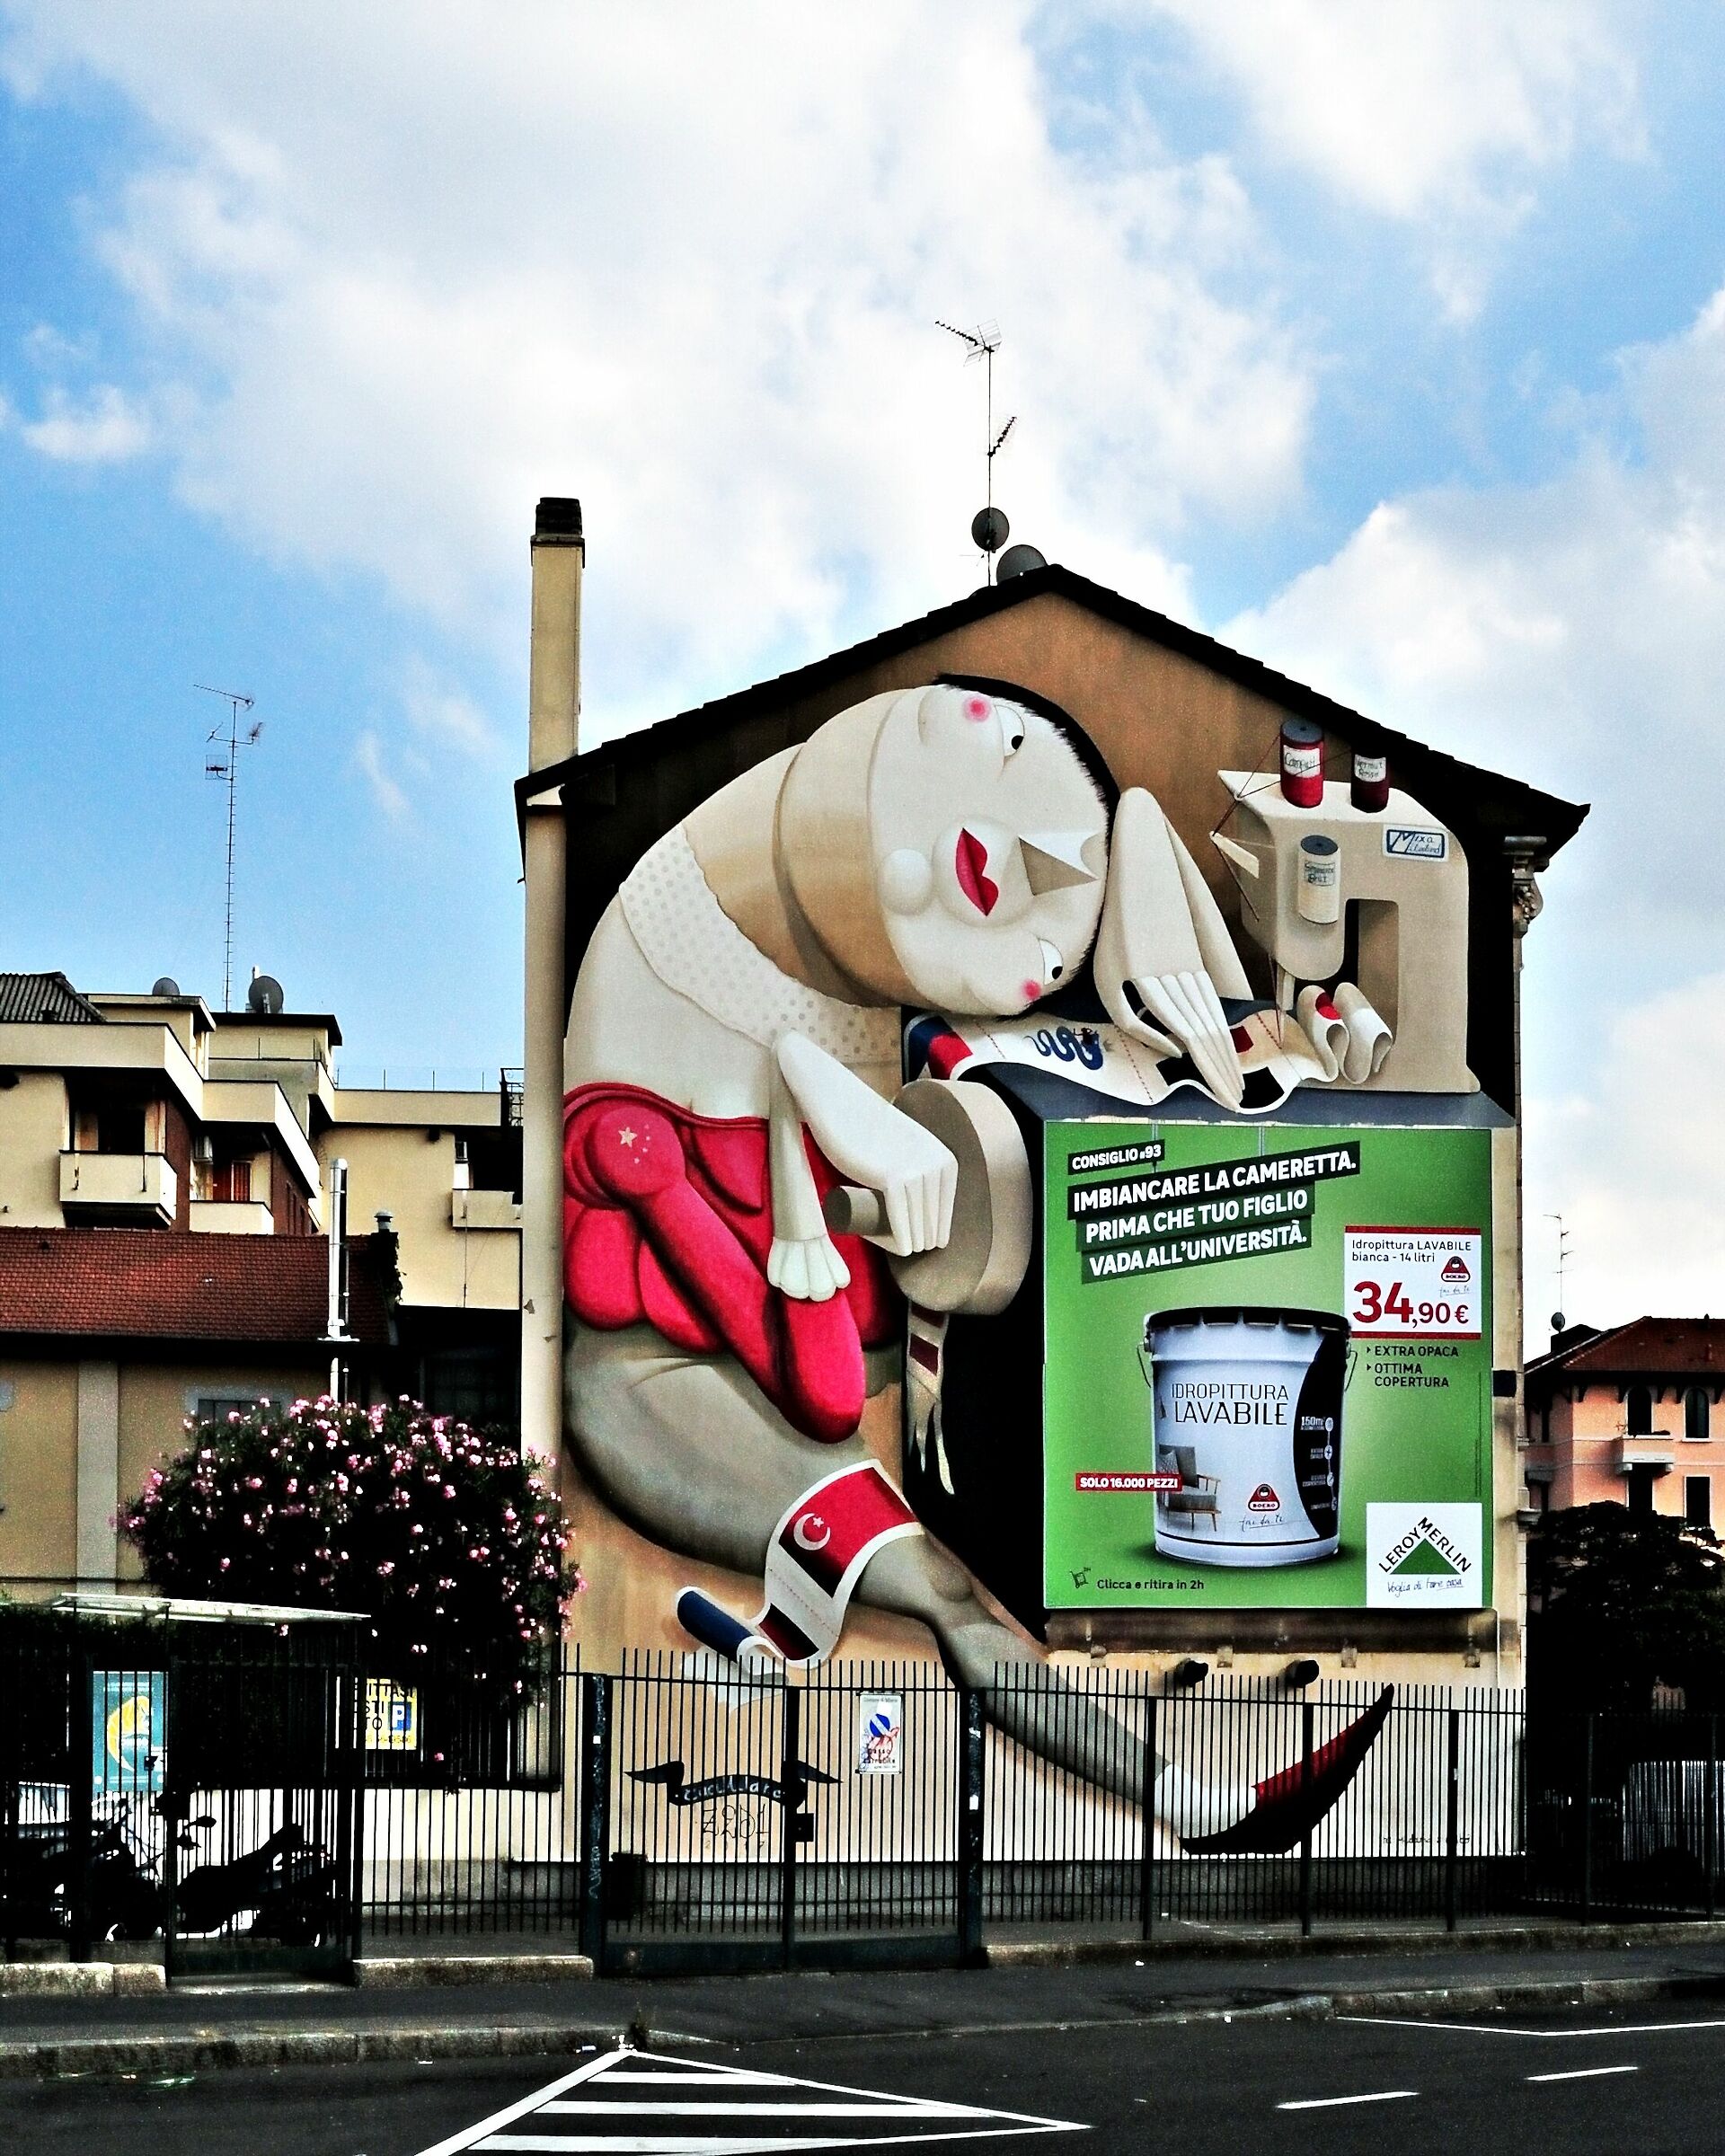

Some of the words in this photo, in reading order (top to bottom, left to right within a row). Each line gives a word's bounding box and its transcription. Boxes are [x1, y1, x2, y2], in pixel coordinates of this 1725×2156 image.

[1072, 1148, 1138, 1170] CONSIGLIO
[1074, 1173, 1199, 1212] IMBIANCARE
[1204, 1171, 1230, 1191] LA
[1233, 1151, 1357, 1187] CAMERETTA.
[1085, 1218, 1151, 1243] PRIMA
[1154, 1206, 1196, 1232] CHE
[1198, 1202, 1240, 1224] TUO
[1243, 1189, 1307, 1218] FIGLIO
[1352, 1239, 1414, 1251] Idropittura
[1417, 1241, 1472, 1251] LAVABILE
[1352, 1251, 1389, 1262] bianca
[1400, 1252, 1411, 1262] 14
[1414, 1252, 1435, 1262] litri
[1089, 1253, 1144, 1277] VADA
[1375, 1346, 1415, 1356] EXTRA
[1418, 1346, 1459, 1356] OPACA
[1375, 1363, 1422, 1374] OTTIMA
[1375, 1376, 1449, 1387] COPERTURA
[1172, 1383, 1289, 1401] IDROPITTURA
[1174, 1401, 1288, 1426] LAVABILE
[1080, 1477, 1109, 1489] SOLO
[1110, 1477, 1145, 1489] 16.000
[1146, 1478, 1178, 1489] PEZZI
[1378, 1526, 1420, 1573] LEROY
[1418, 1516, 1472, 1573] MERLIN
[1097, 1579, 1132, 1589] Clicca
[1144, 1579, 1173, 1589] ritira
[1176, 1579, 1187, 1589] in
[1190, 1579, 1205, 1589] 2h
